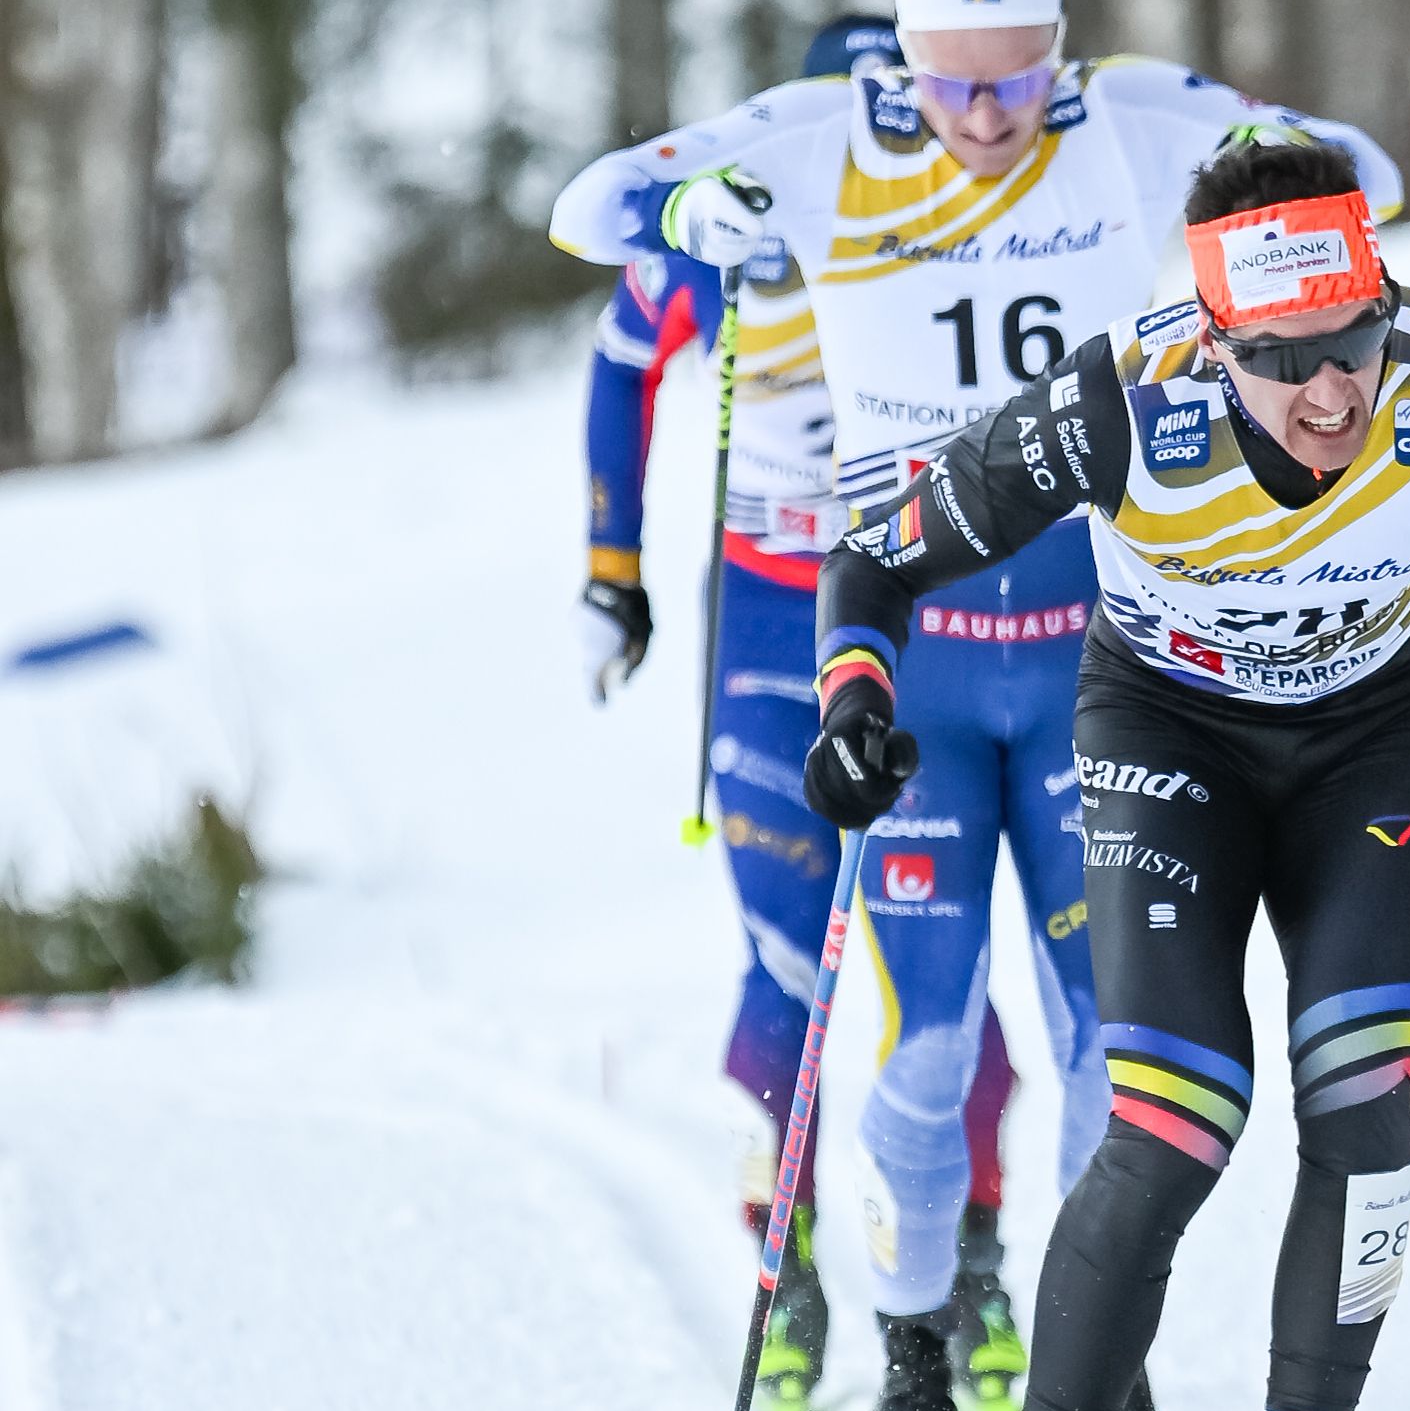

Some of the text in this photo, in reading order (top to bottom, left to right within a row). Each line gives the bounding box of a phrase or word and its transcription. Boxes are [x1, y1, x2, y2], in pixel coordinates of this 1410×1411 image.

[1230, 239, 1331, 274] ANDBANK
[1264, 256, 1330, 276] Private Bankers
[931, 294, 1066, 388] 16
[855, 391, 955, 426] STATION
[1069, 418, 1092, 455] Aker
[1150, 432, 1207, 447] WORLD CUP
[1155, 445, 1200, 462] coop
[1056, 421, 1090, 490] Solutions
[940, 477, 991, 558] GRANDVALIRA
[1154, 555, 1287, 587] Biscuits
[922, 603, 1085, 641] BAUHAUS
[1087, 843, 1199, 894] ALTAVISTA
[1358, 1220, 1409, 1266] 28
